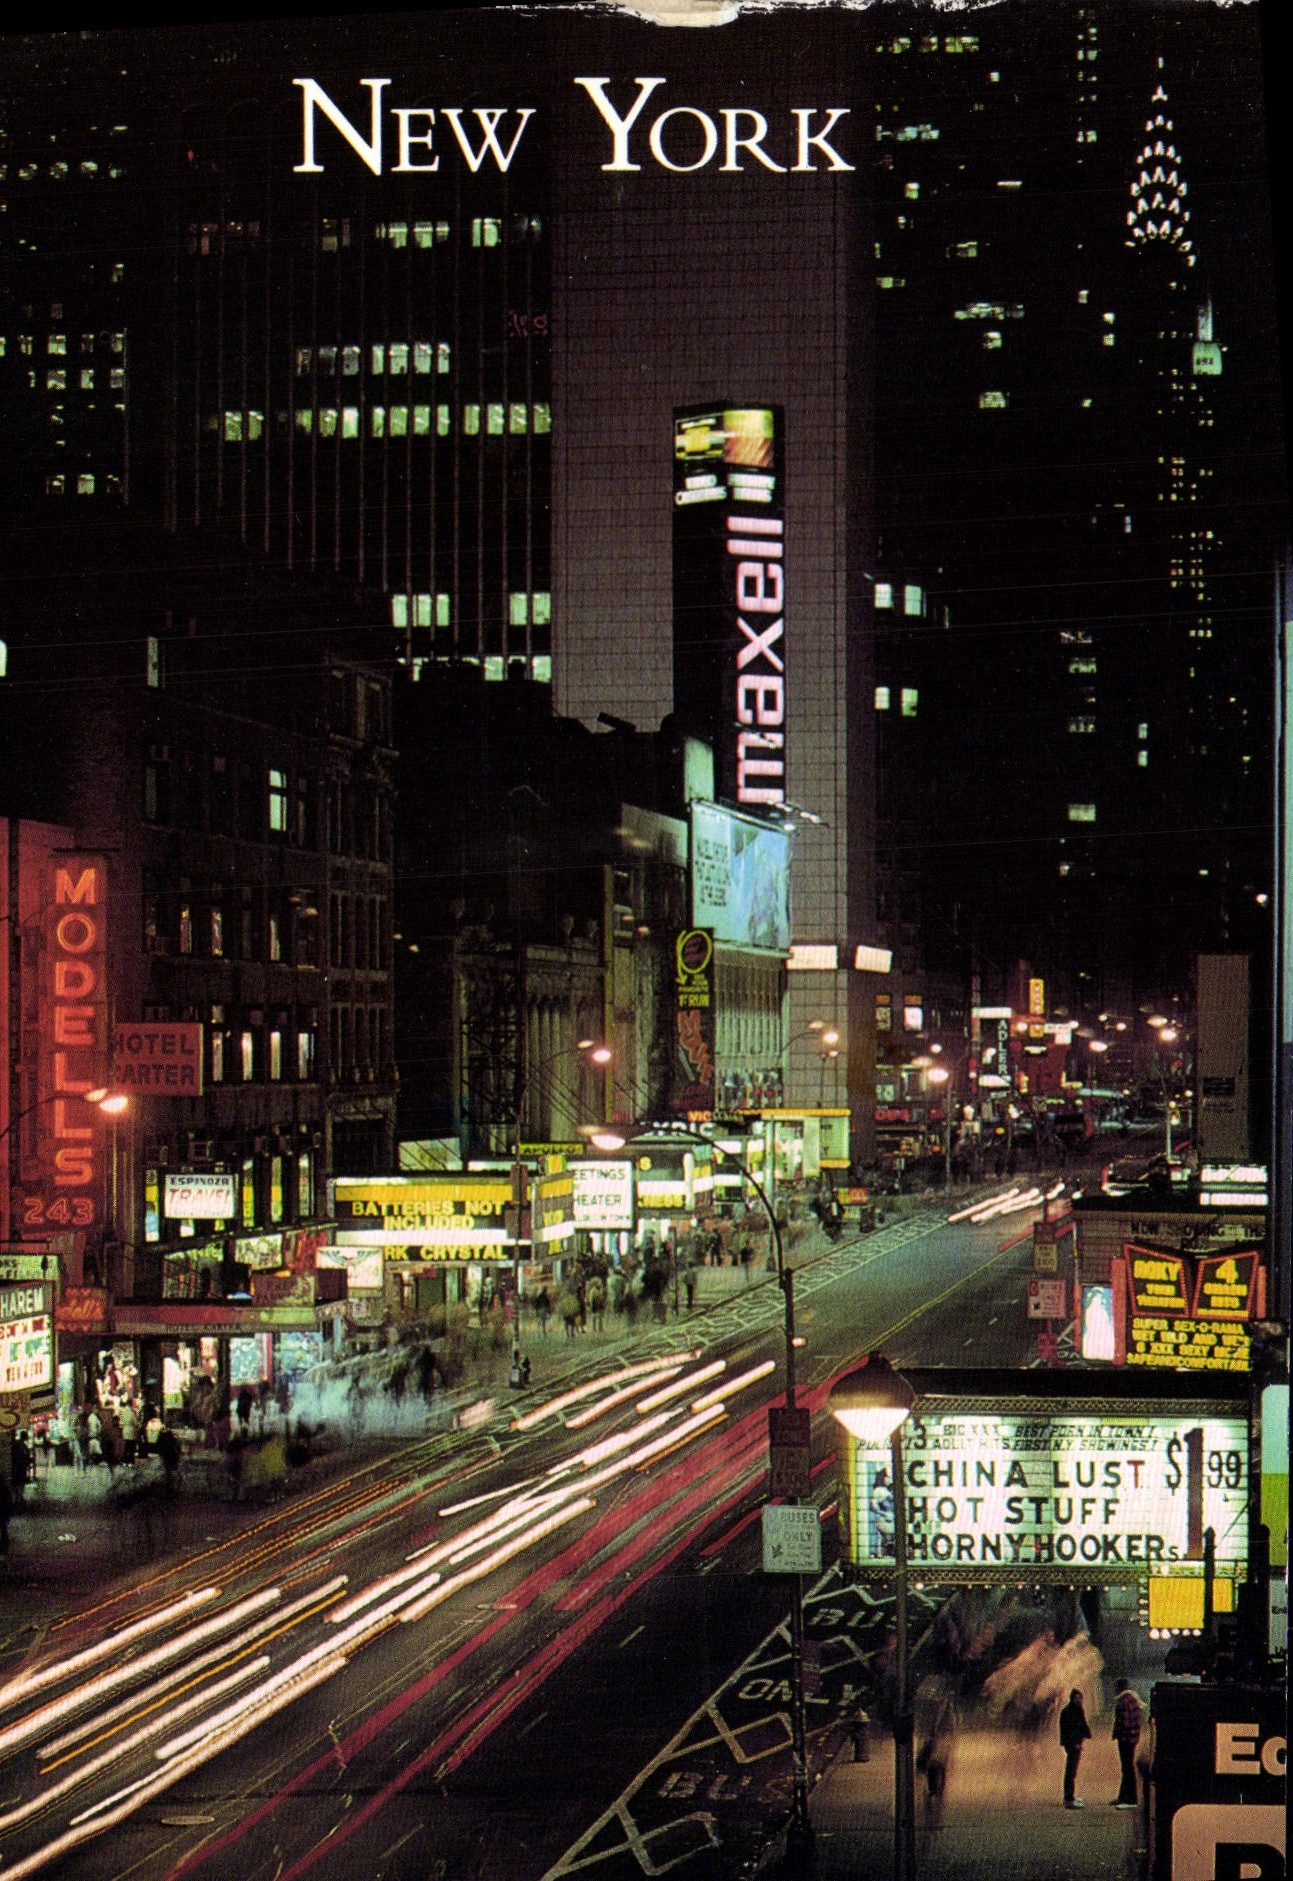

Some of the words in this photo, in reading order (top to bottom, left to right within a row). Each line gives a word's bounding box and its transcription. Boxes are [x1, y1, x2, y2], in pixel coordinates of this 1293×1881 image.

[727, 515, 784, 803] maxell
[24, 1197, 95, 1225] 243
[352, 1201, 455, 1217] BATTERIES
[465, 1201, 505, 1217] NOT
[383, 1216, 475, 1231] INCLUDED
[419, 1246, 508, 1260] CRYSTAL
[1215, 1258, 1239, 1284] 4
[0, 1287, 44, 1318] HAREM
[1132, 1318, 1168, 1331] SUPER
[1131, 1330, 1156, 1343] WET
[1192, 1334, 1218, 1347] AND
[1150, 1343, 1174, 1356] XXX
[1179, 1344, 1210, 1358] SEXY
[907, 1460, 1028, 1488] CHINA
[1053, 1460, 1145, 1488] LUST
[908, 1496, 984, 1524] HOT
[1004, 1496, 1120, 1525] STUFF
